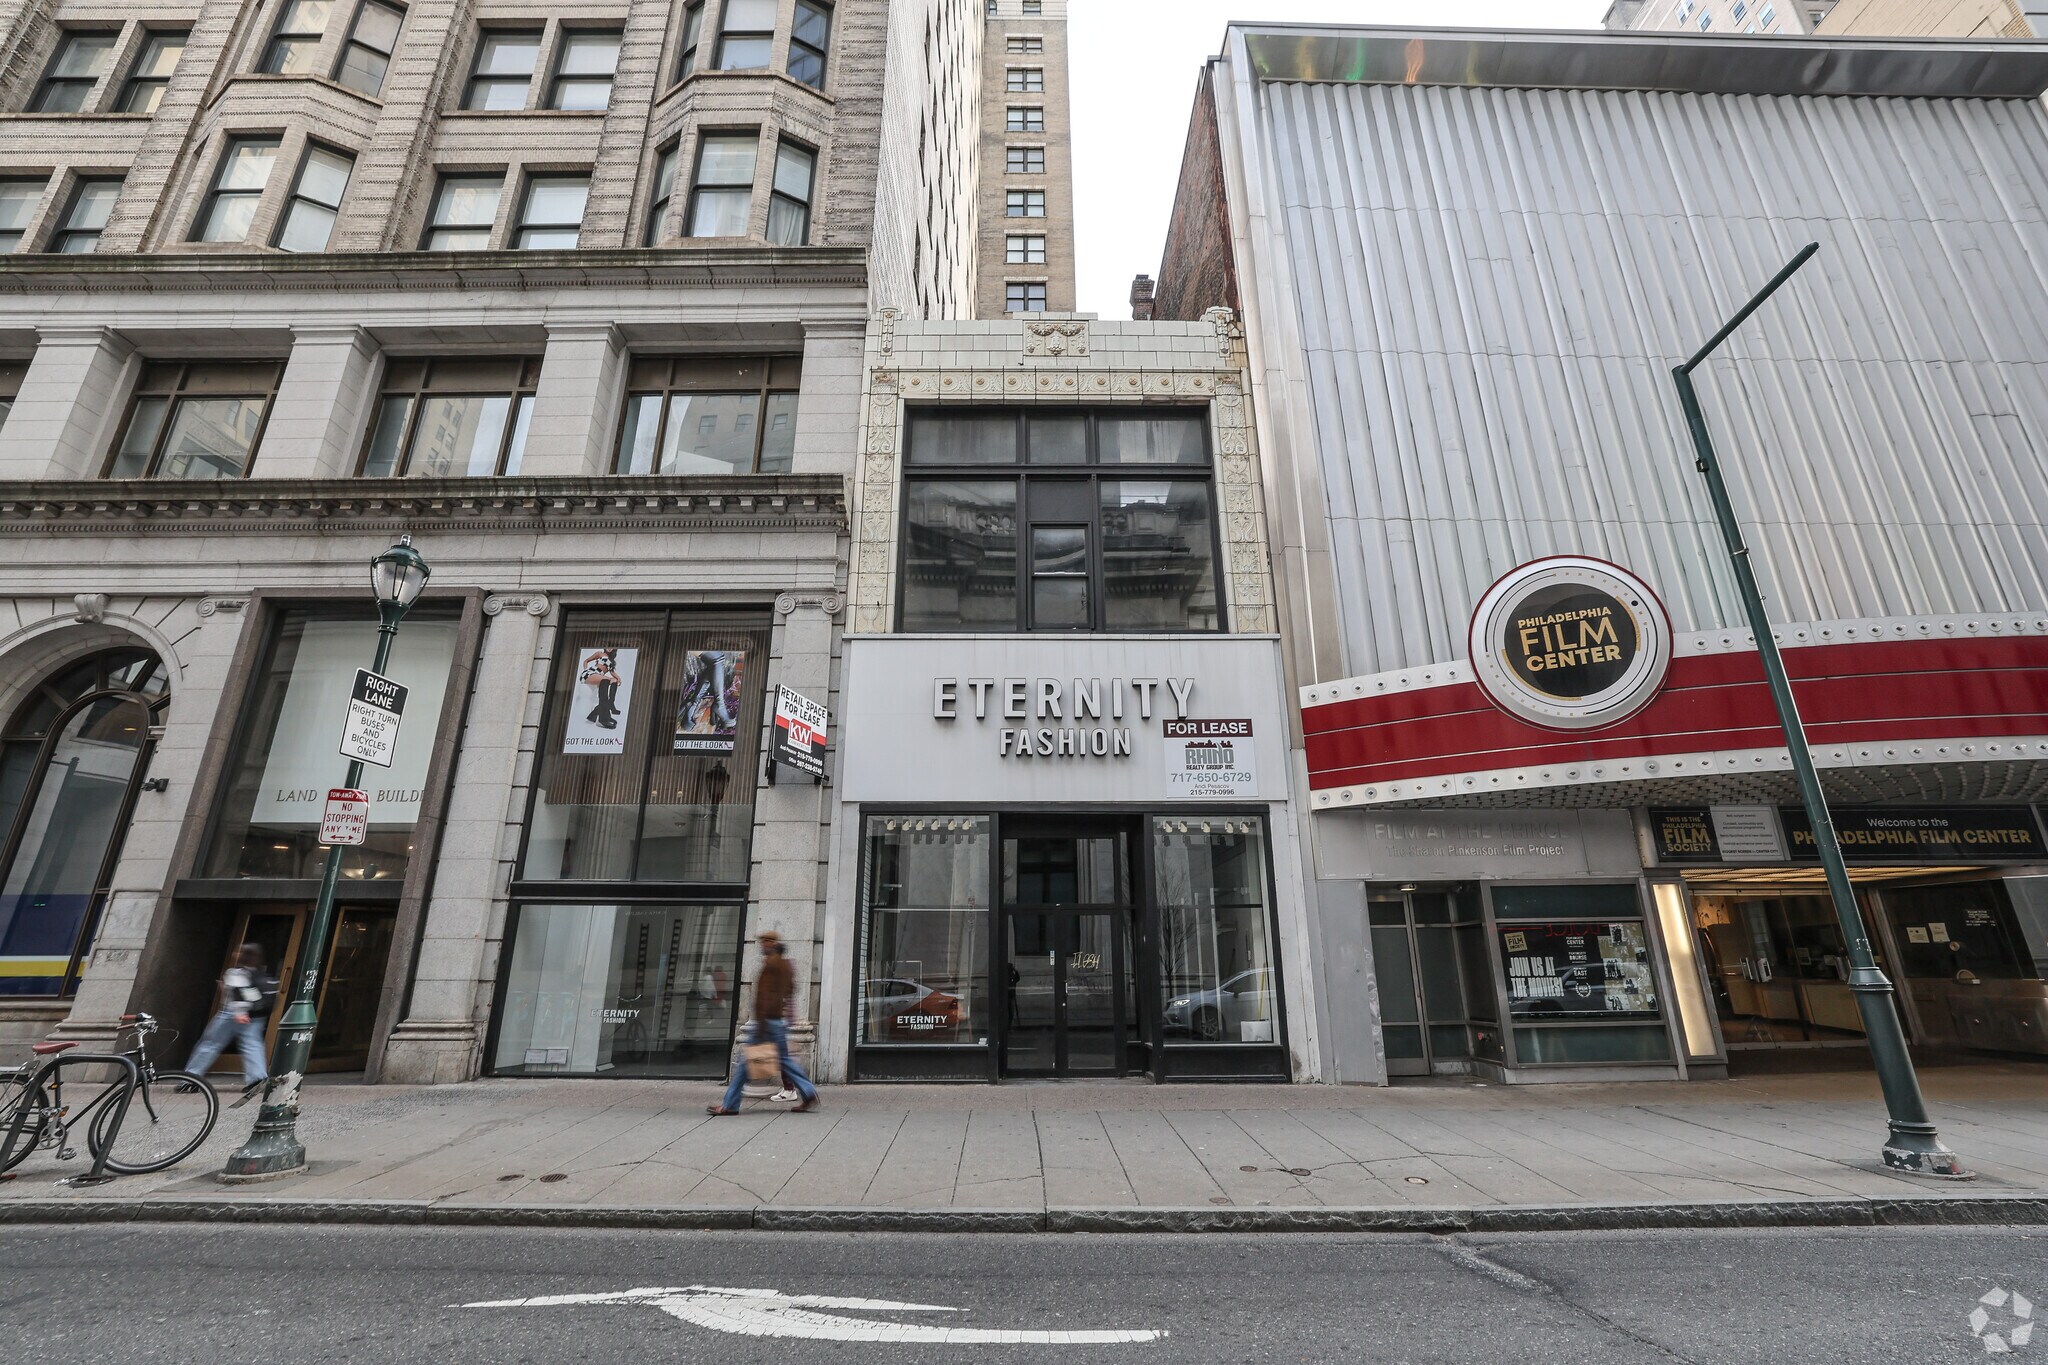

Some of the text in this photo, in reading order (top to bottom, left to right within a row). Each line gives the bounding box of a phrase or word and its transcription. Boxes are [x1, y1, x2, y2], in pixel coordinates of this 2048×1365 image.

[1517, 606, 1612, 629] PHILADELPHIA
[1519, 616, 1619, 656] FILM
[1526, 644, 1622, 672] CENTER
[365, 676, 399, 697] RIGHT
[364, 690, 394, 709] LANE
[780, 687, 826, 718] RETAIL SPACE
[933, 677, 1195, 720] ETERNITY
[352, 703, 398, 726] RIGHT TURN
[784, 701, 821, 727] FOR LEASE
[361, 717, 385, 731] BUSES
[1167, 722, 1248, 734] FOR LEASE
[362, 728, 380, 739] AND
[789, 722, 811, 744] KW
[351, 733, 386, 751] BICYCLES
[565, 737, 616, 746] GOT THE LOOK
[674, 740, 724, 749] GOT THE LOOK
[1000, 728, 1131, 757] FASHION
[357, 745, 377, 757] ONLY
[1185, 747, 1235, 765] RHINO
[1170, 772, 1252, 782] 717-650-6729
[276, 789, 318, 802] LAND
[341, 802, 353, 812] NO
[326, 813, 364, 824] STOPPING
[1866, 817, 1949, 828] Welcome to the
[1374, 823, 1420, 840] FILM
[1457, 824, 1492, 840] THE
[1663, 828, 1711, 844] FILM
[1792, 829, 2032, 845] PHADELPHIA FILM CENTER
[1387, 845, 1404, 857] The
[1448, 845, 1500, 857] Pinkenson
[1503, 844, 1525, 857] Film
[1528, 844, 1565, 860] Project
[1668, 843, 1711, 852] SOCIETY
[1509, 956, 1556, 977] JOIN US AT
[1510, 976, 1565, 998] THE MOVIES!
[591, 1009, 641, 1018] ETERNITY
[896, 1015, 948, 1024] ETERNITY
